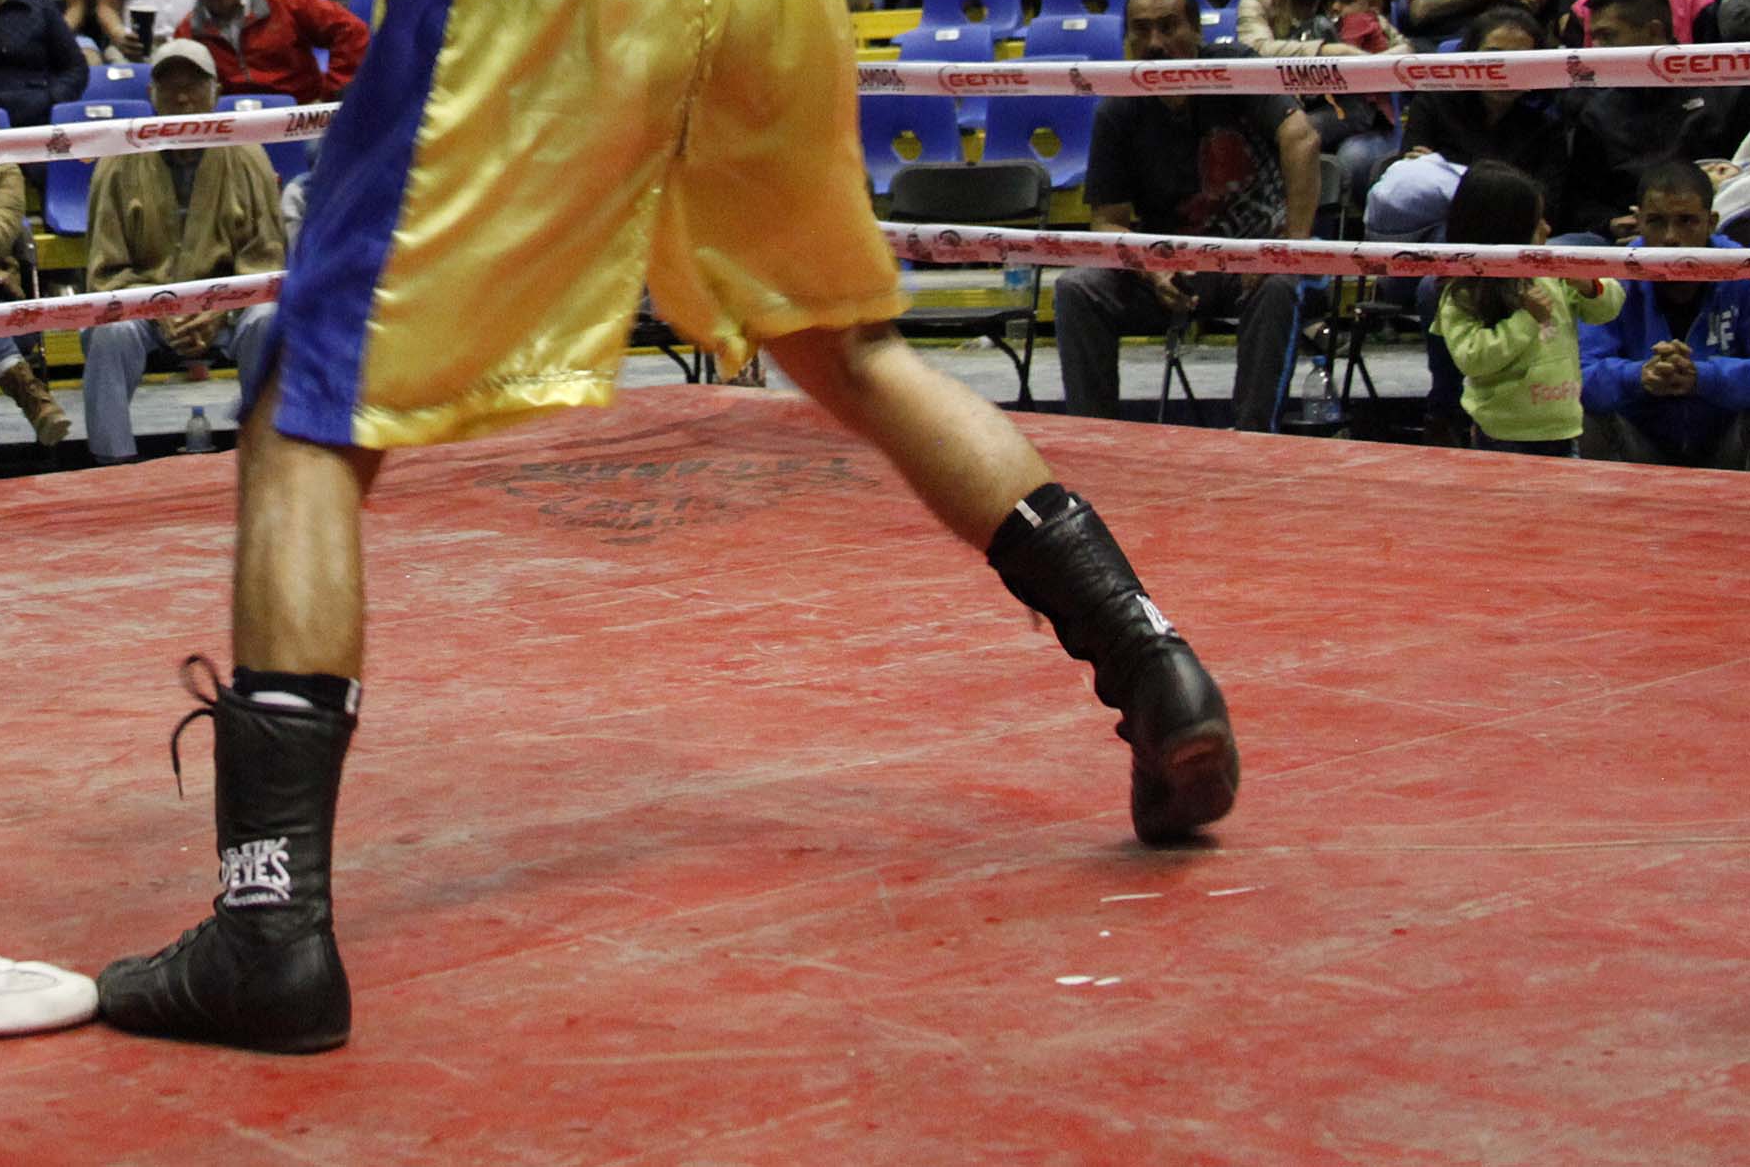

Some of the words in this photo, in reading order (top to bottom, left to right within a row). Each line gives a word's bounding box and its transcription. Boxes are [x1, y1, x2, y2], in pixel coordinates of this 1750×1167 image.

[1142, 69, 1232, 83] GENTE
[1276, 64, 1347, 86] ZAMORA
[1407, 64, 1507, 80] GENTE
[138, 119, 236, 139] GENTE
